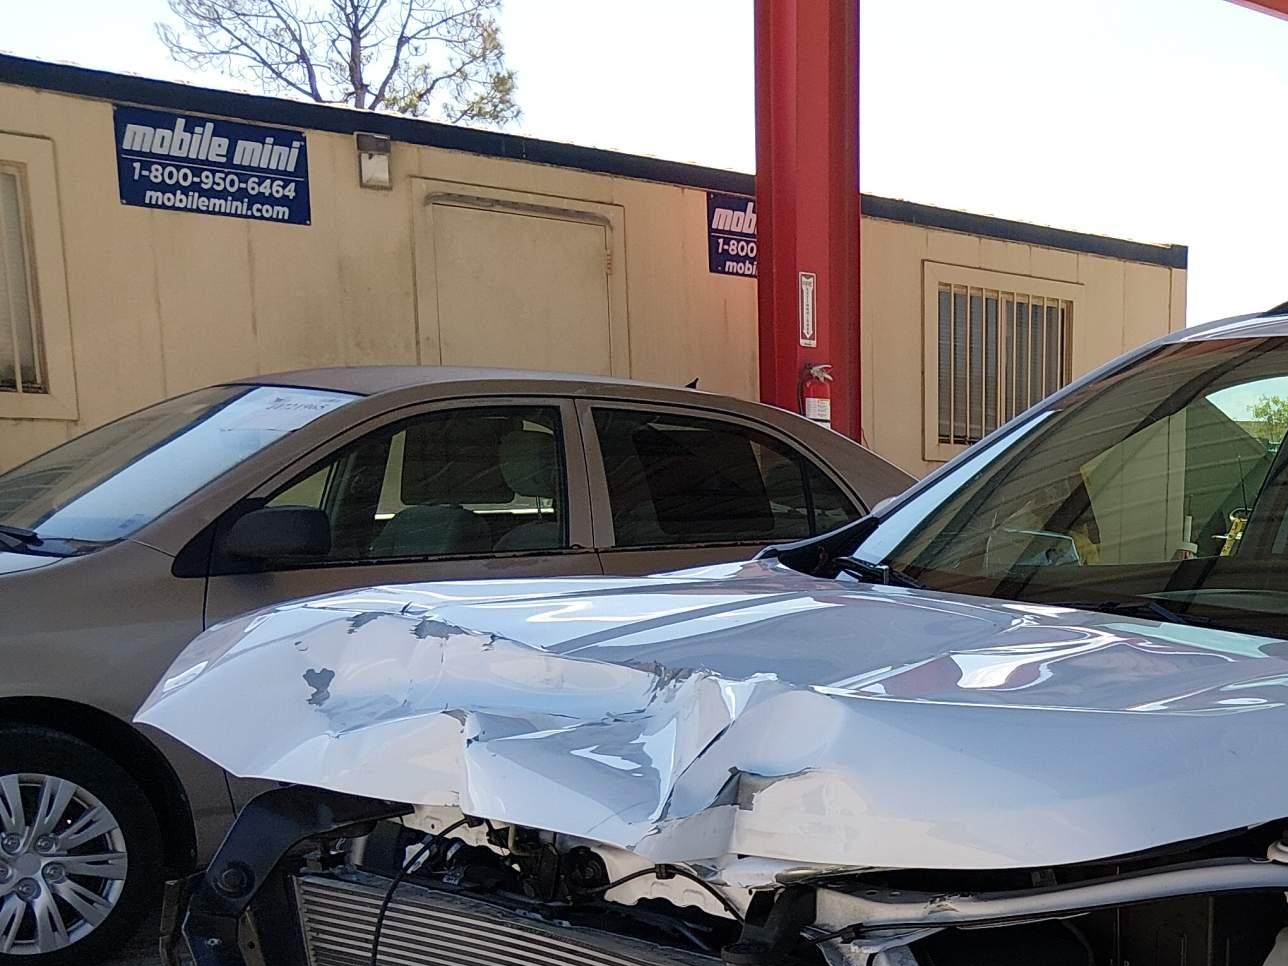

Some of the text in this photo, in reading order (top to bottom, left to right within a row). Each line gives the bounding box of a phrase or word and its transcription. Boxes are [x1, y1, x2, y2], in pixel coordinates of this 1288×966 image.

[122, 118, 301, 172] mobile mini
[132, 162, 296, 199] 1-800-950-6464
[145, 190, 290, 220] mobilemini.com
[711, 202, 758, 235] mob
[724, 260, 758, 276] mobi
